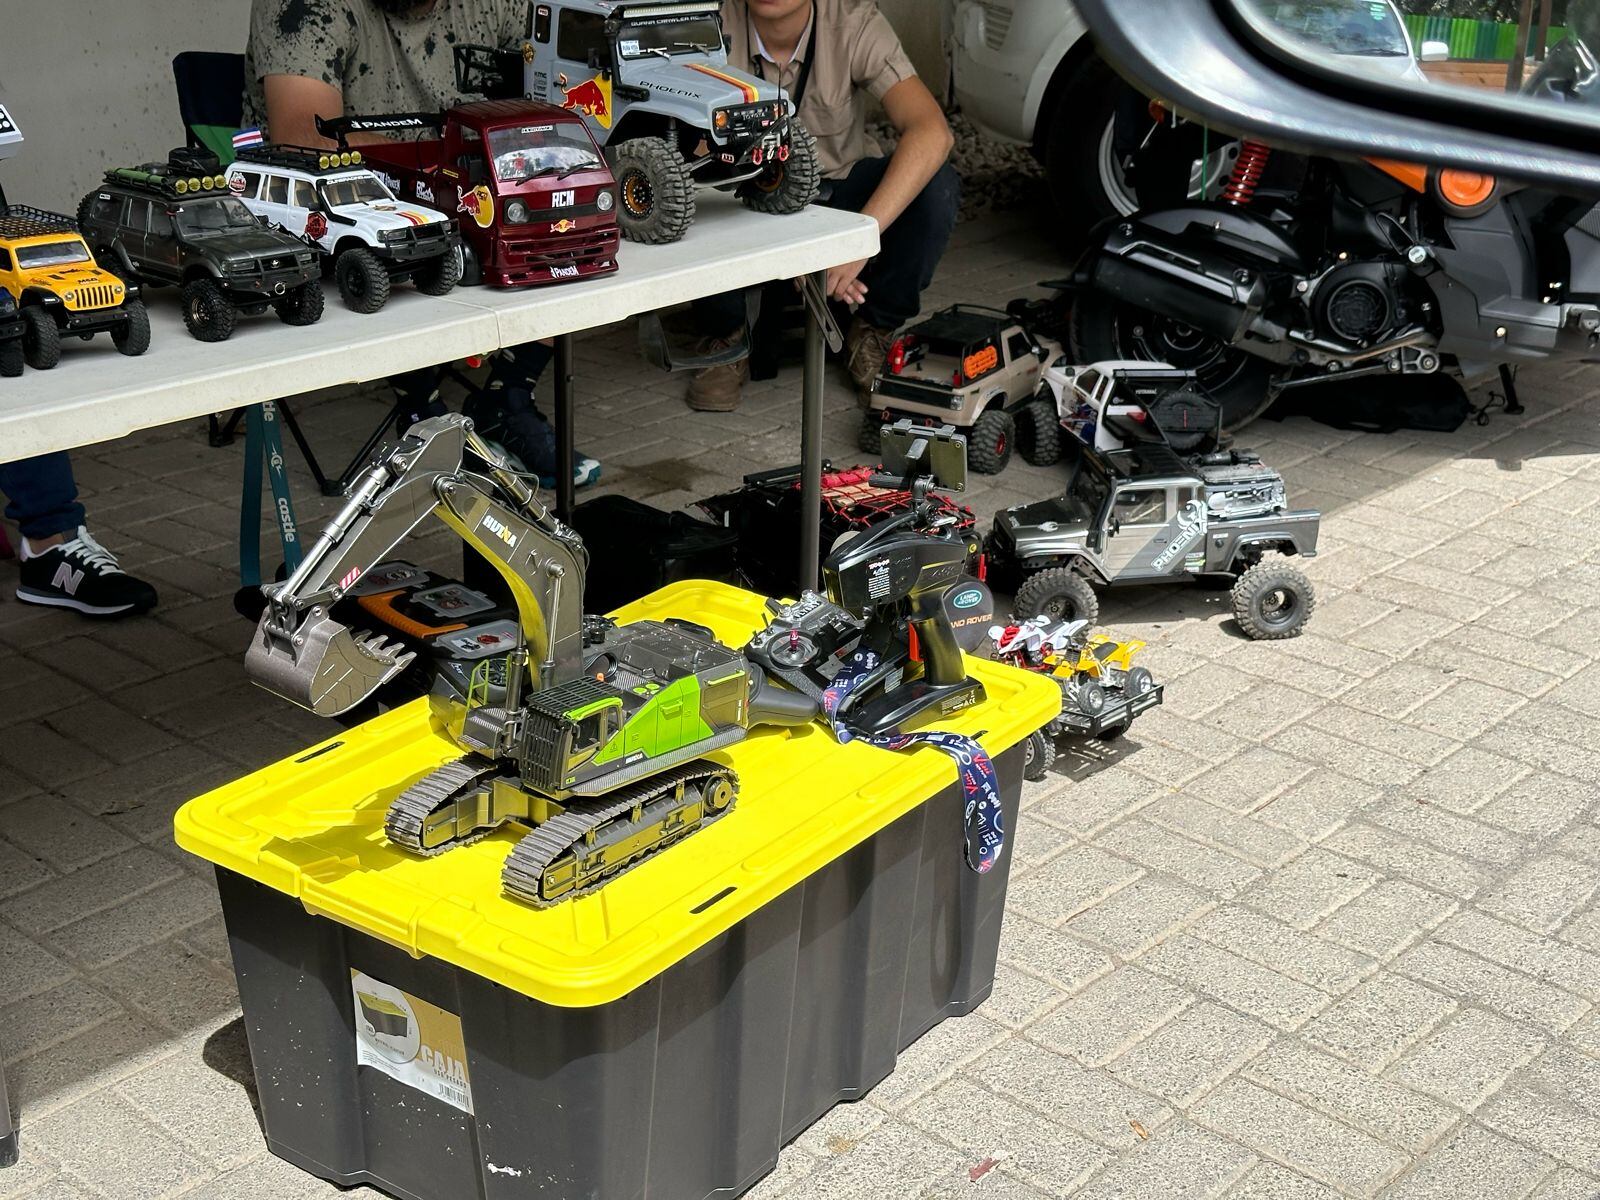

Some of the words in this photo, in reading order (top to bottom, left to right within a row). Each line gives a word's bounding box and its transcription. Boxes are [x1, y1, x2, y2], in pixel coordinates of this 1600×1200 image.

[640, 81, 701, 98] PHOENIX
[361, 118, 423, 128] PANDEM
[552, 190, 575, 208] RCM
[554, 265, 580, 278] PANDEM
[278, 497, 297, 543] castle
[1151, 518, 1208, 572] PHOENIX
[51, 562, 85, 595] N
[966, 613, 993, 625] ROVER
